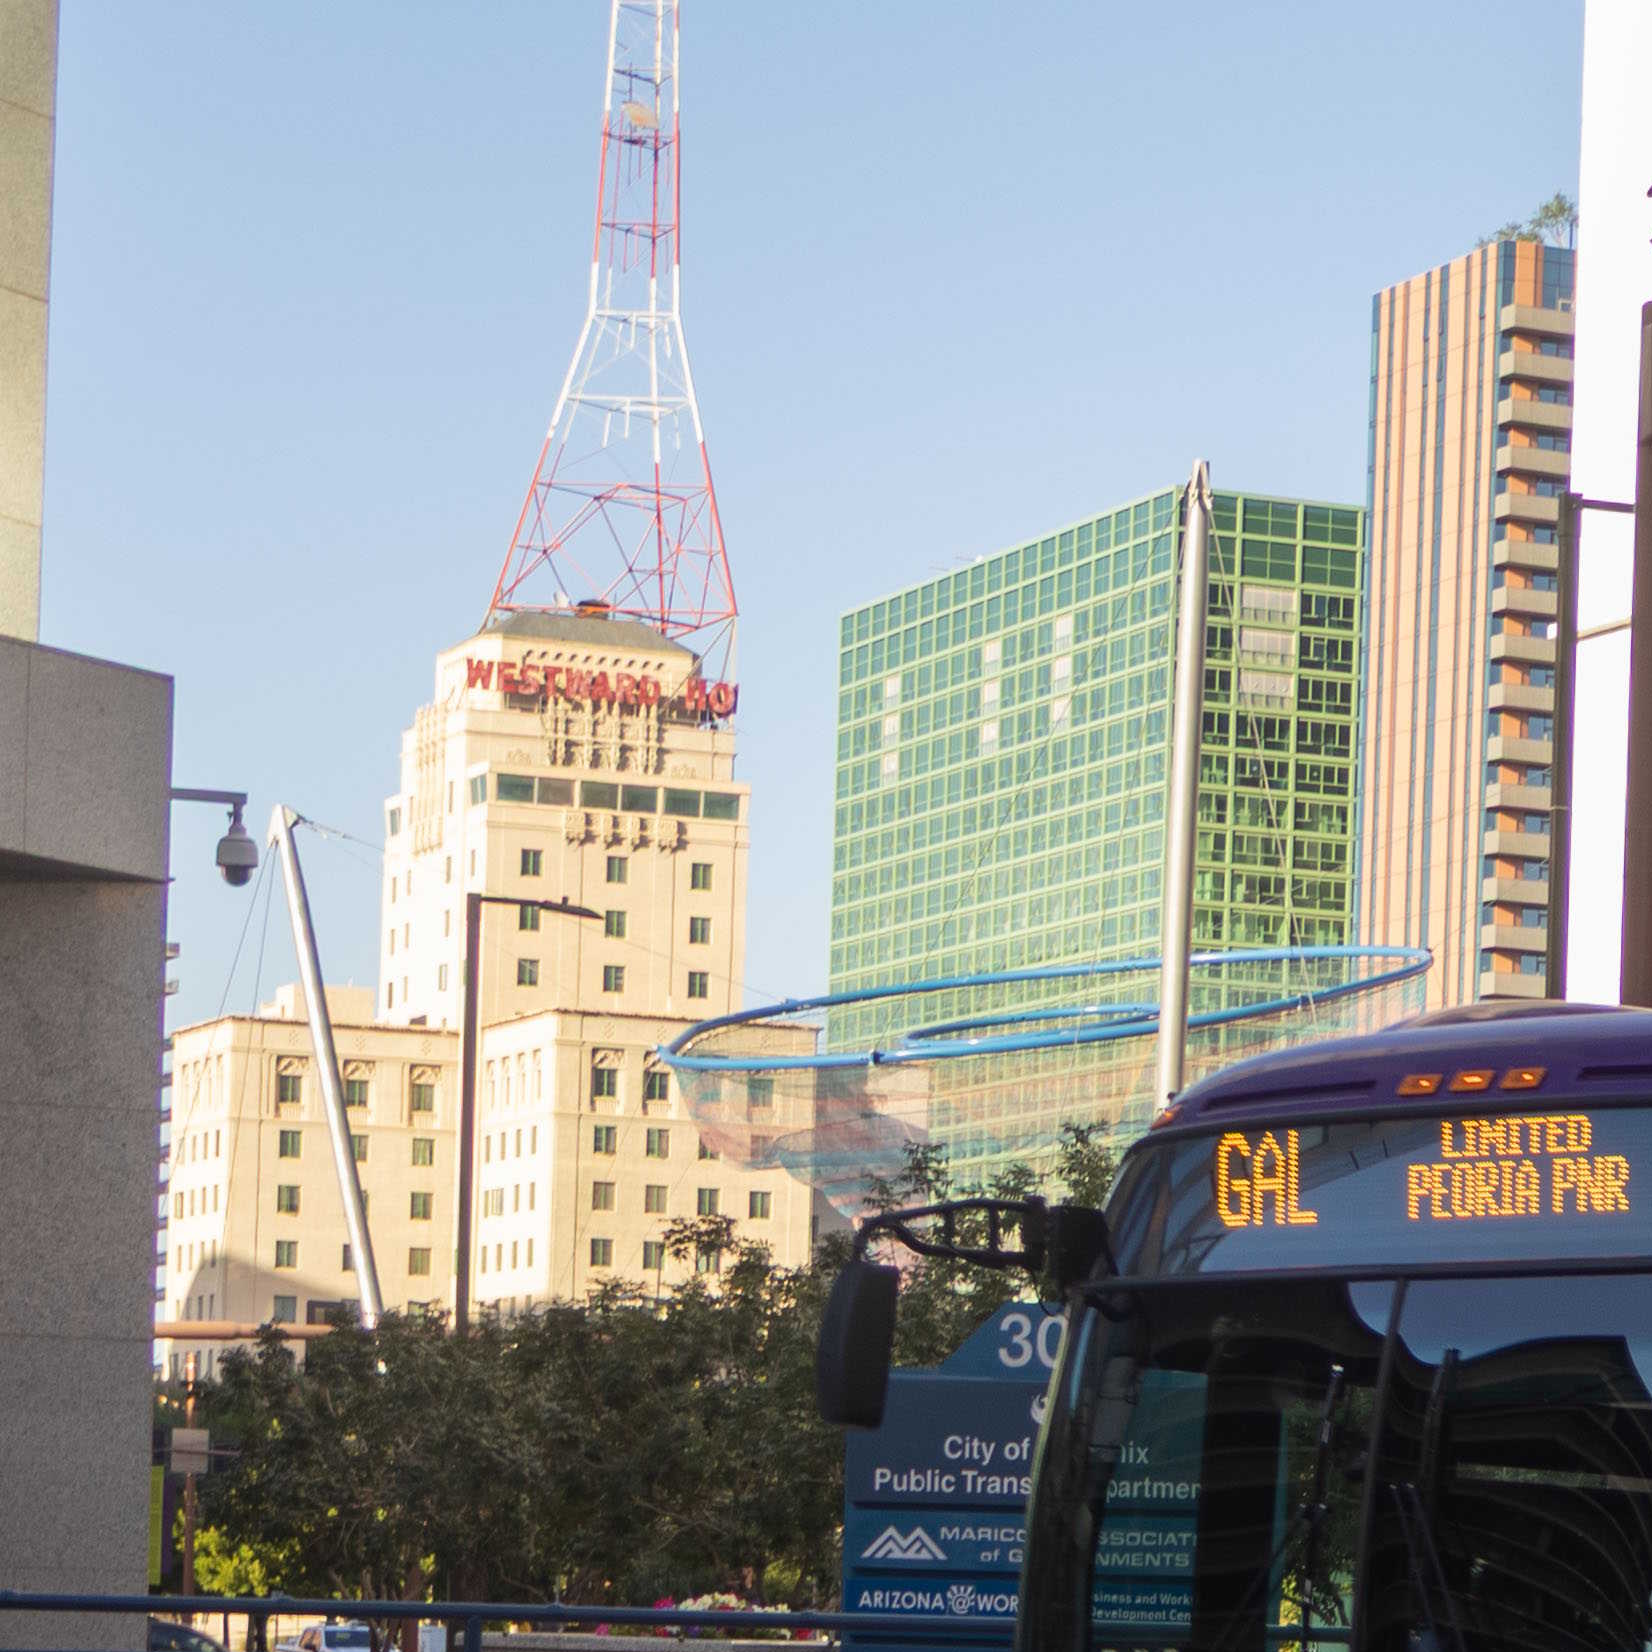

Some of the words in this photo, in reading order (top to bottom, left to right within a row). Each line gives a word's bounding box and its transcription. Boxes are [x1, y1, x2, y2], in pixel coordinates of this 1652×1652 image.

[466, 657, 661, 707] WESTWARD
[686, 677, 738, 717] HO
[1441, 1114, 1593, 1160] LIMITED
[1217, 1130, 1319, 1229] GAL
[1407, 1159, 1541, 1221] PEORIA
[1551, 1155, 1631, 1214] PNR
[944, 1435, 996, 1466] City
[1003, 1437, 1031, 1461] of
[874, 1467, 956, 1494] Public
[979, 1549, 999, 1563] of
[1135, 1592, 1157, 1605] and
[1159, 1593, 1193, 1605] Work
